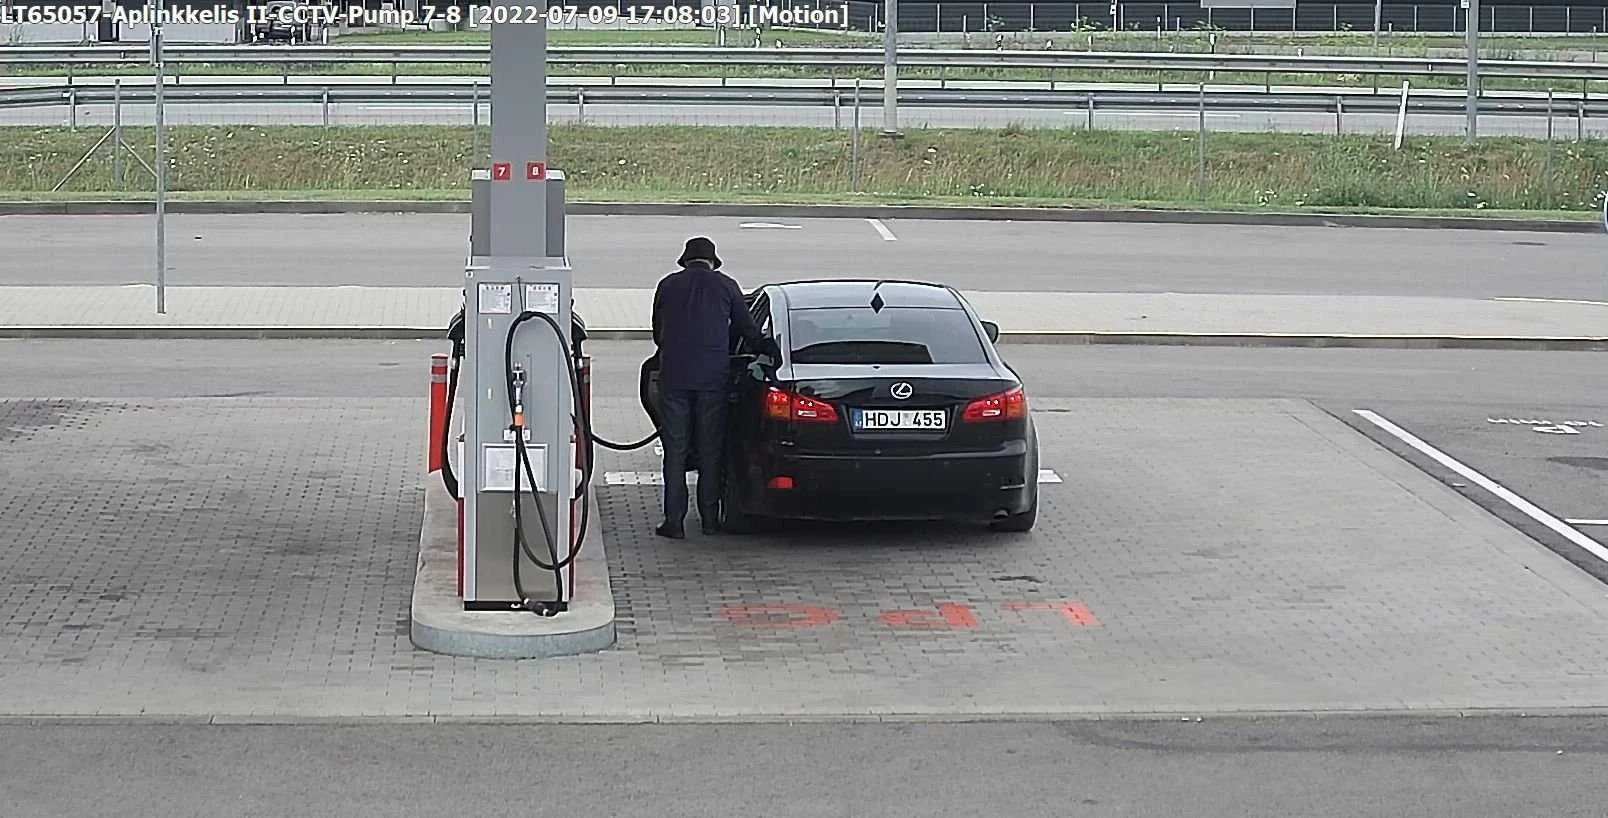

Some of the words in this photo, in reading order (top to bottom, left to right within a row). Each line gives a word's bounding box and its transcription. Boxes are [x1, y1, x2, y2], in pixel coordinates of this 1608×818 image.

[497, 166, 506, 177] 7
[865, 412, 901, 427] HDJ
[912, 412, 943, 427] 455
